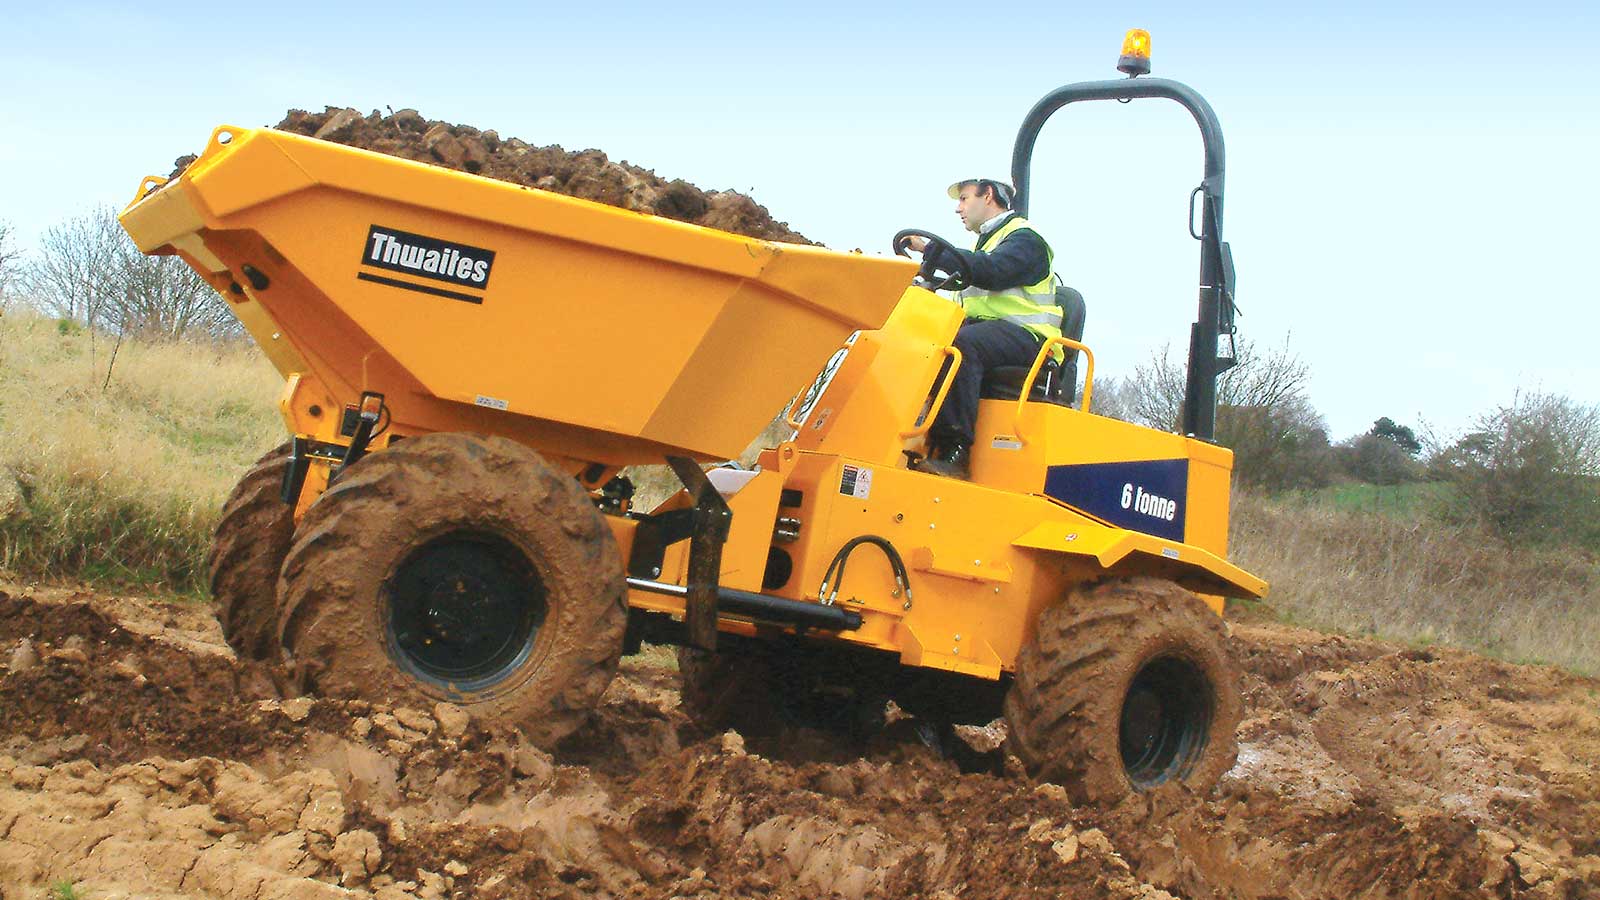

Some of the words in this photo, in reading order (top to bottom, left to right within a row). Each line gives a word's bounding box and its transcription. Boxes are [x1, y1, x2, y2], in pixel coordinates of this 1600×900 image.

[370, 232, 489, 283] Thwaites
[1120, 483, 1133, 509] 6
[1134, 486, 1176, 521] tonne
